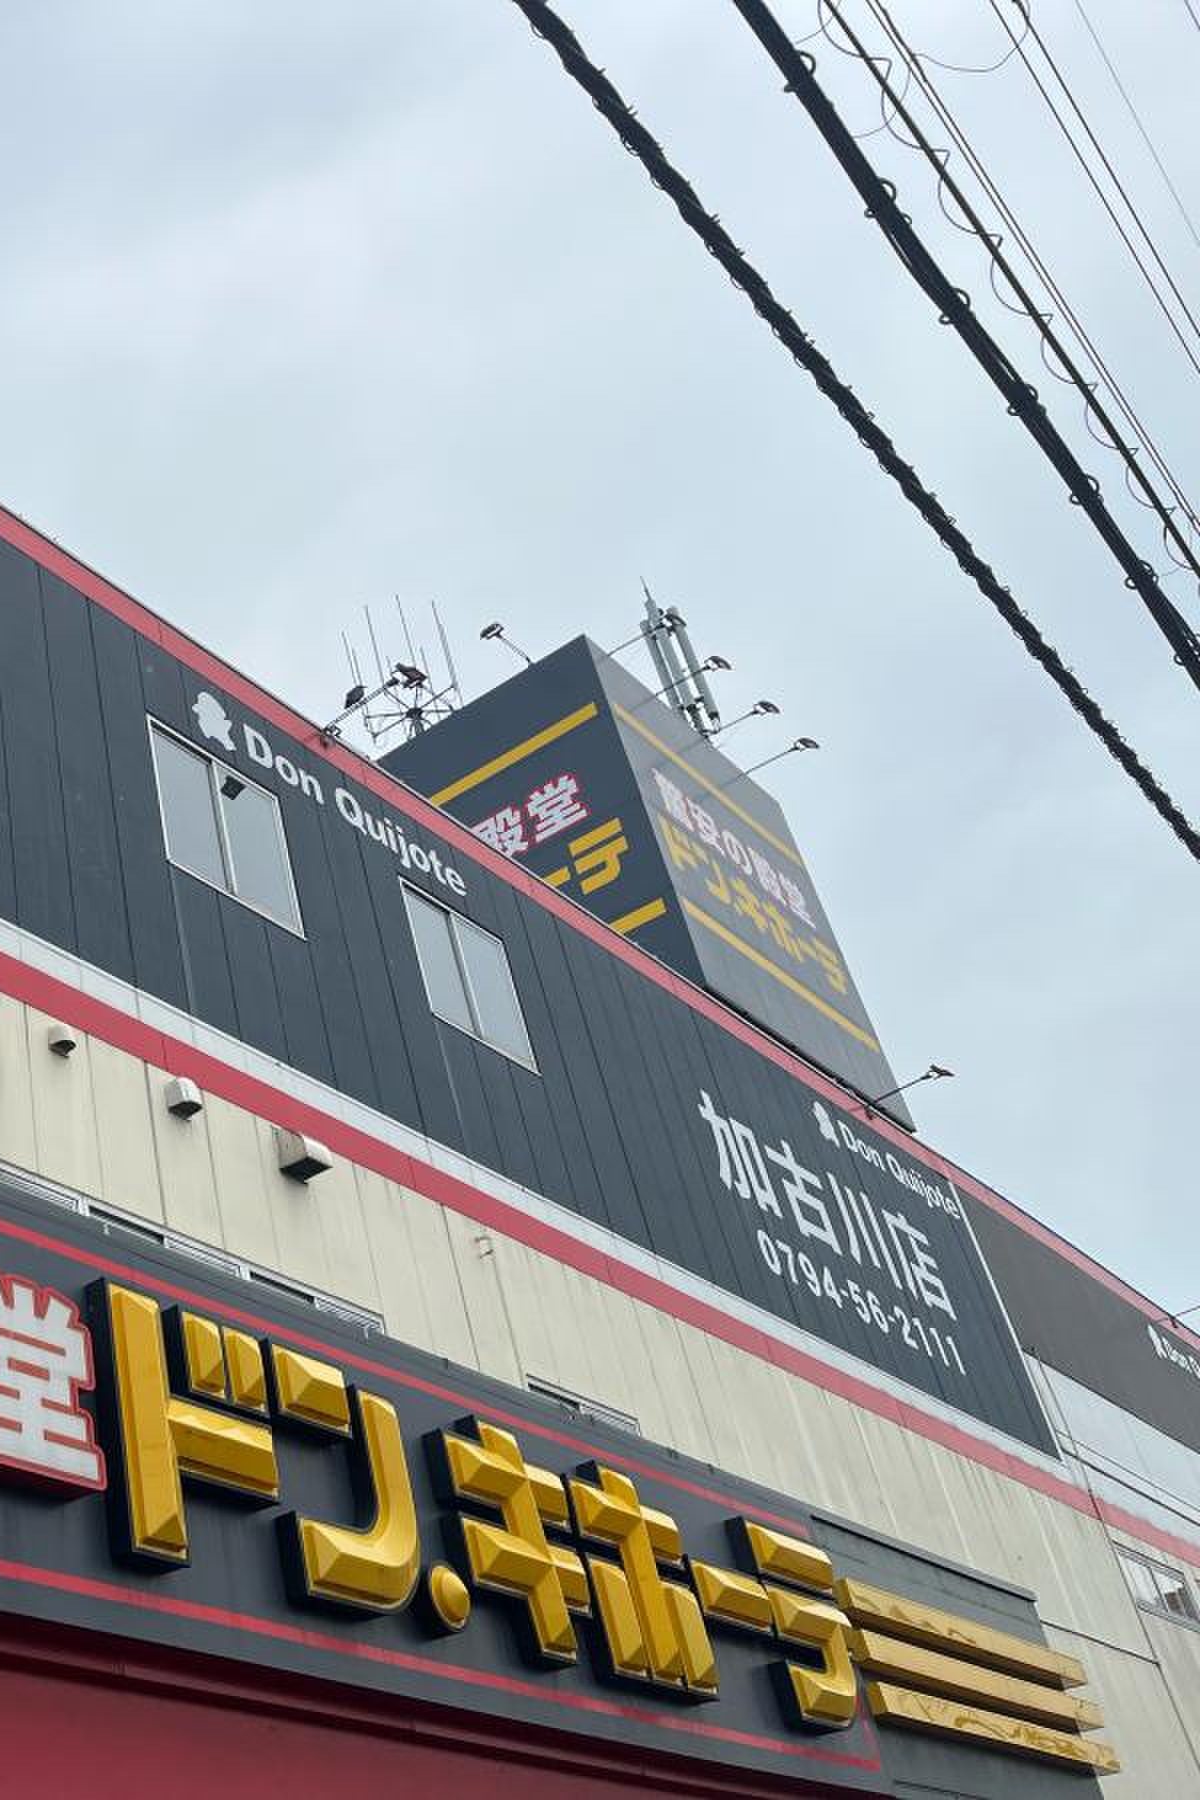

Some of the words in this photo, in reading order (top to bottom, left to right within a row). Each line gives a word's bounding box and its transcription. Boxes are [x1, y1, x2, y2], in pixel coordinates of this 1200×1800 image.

[243, 724, 324, 804] Don
[335, 787, 467, 896] Quijote
[699, 1089, 957, 1322] 加古川店
[837, 1119, 886, 1172] Don
[885, 1152, 961, 1219] Quijote
[757, 1230, 966, 1376] 0794-56-2111
